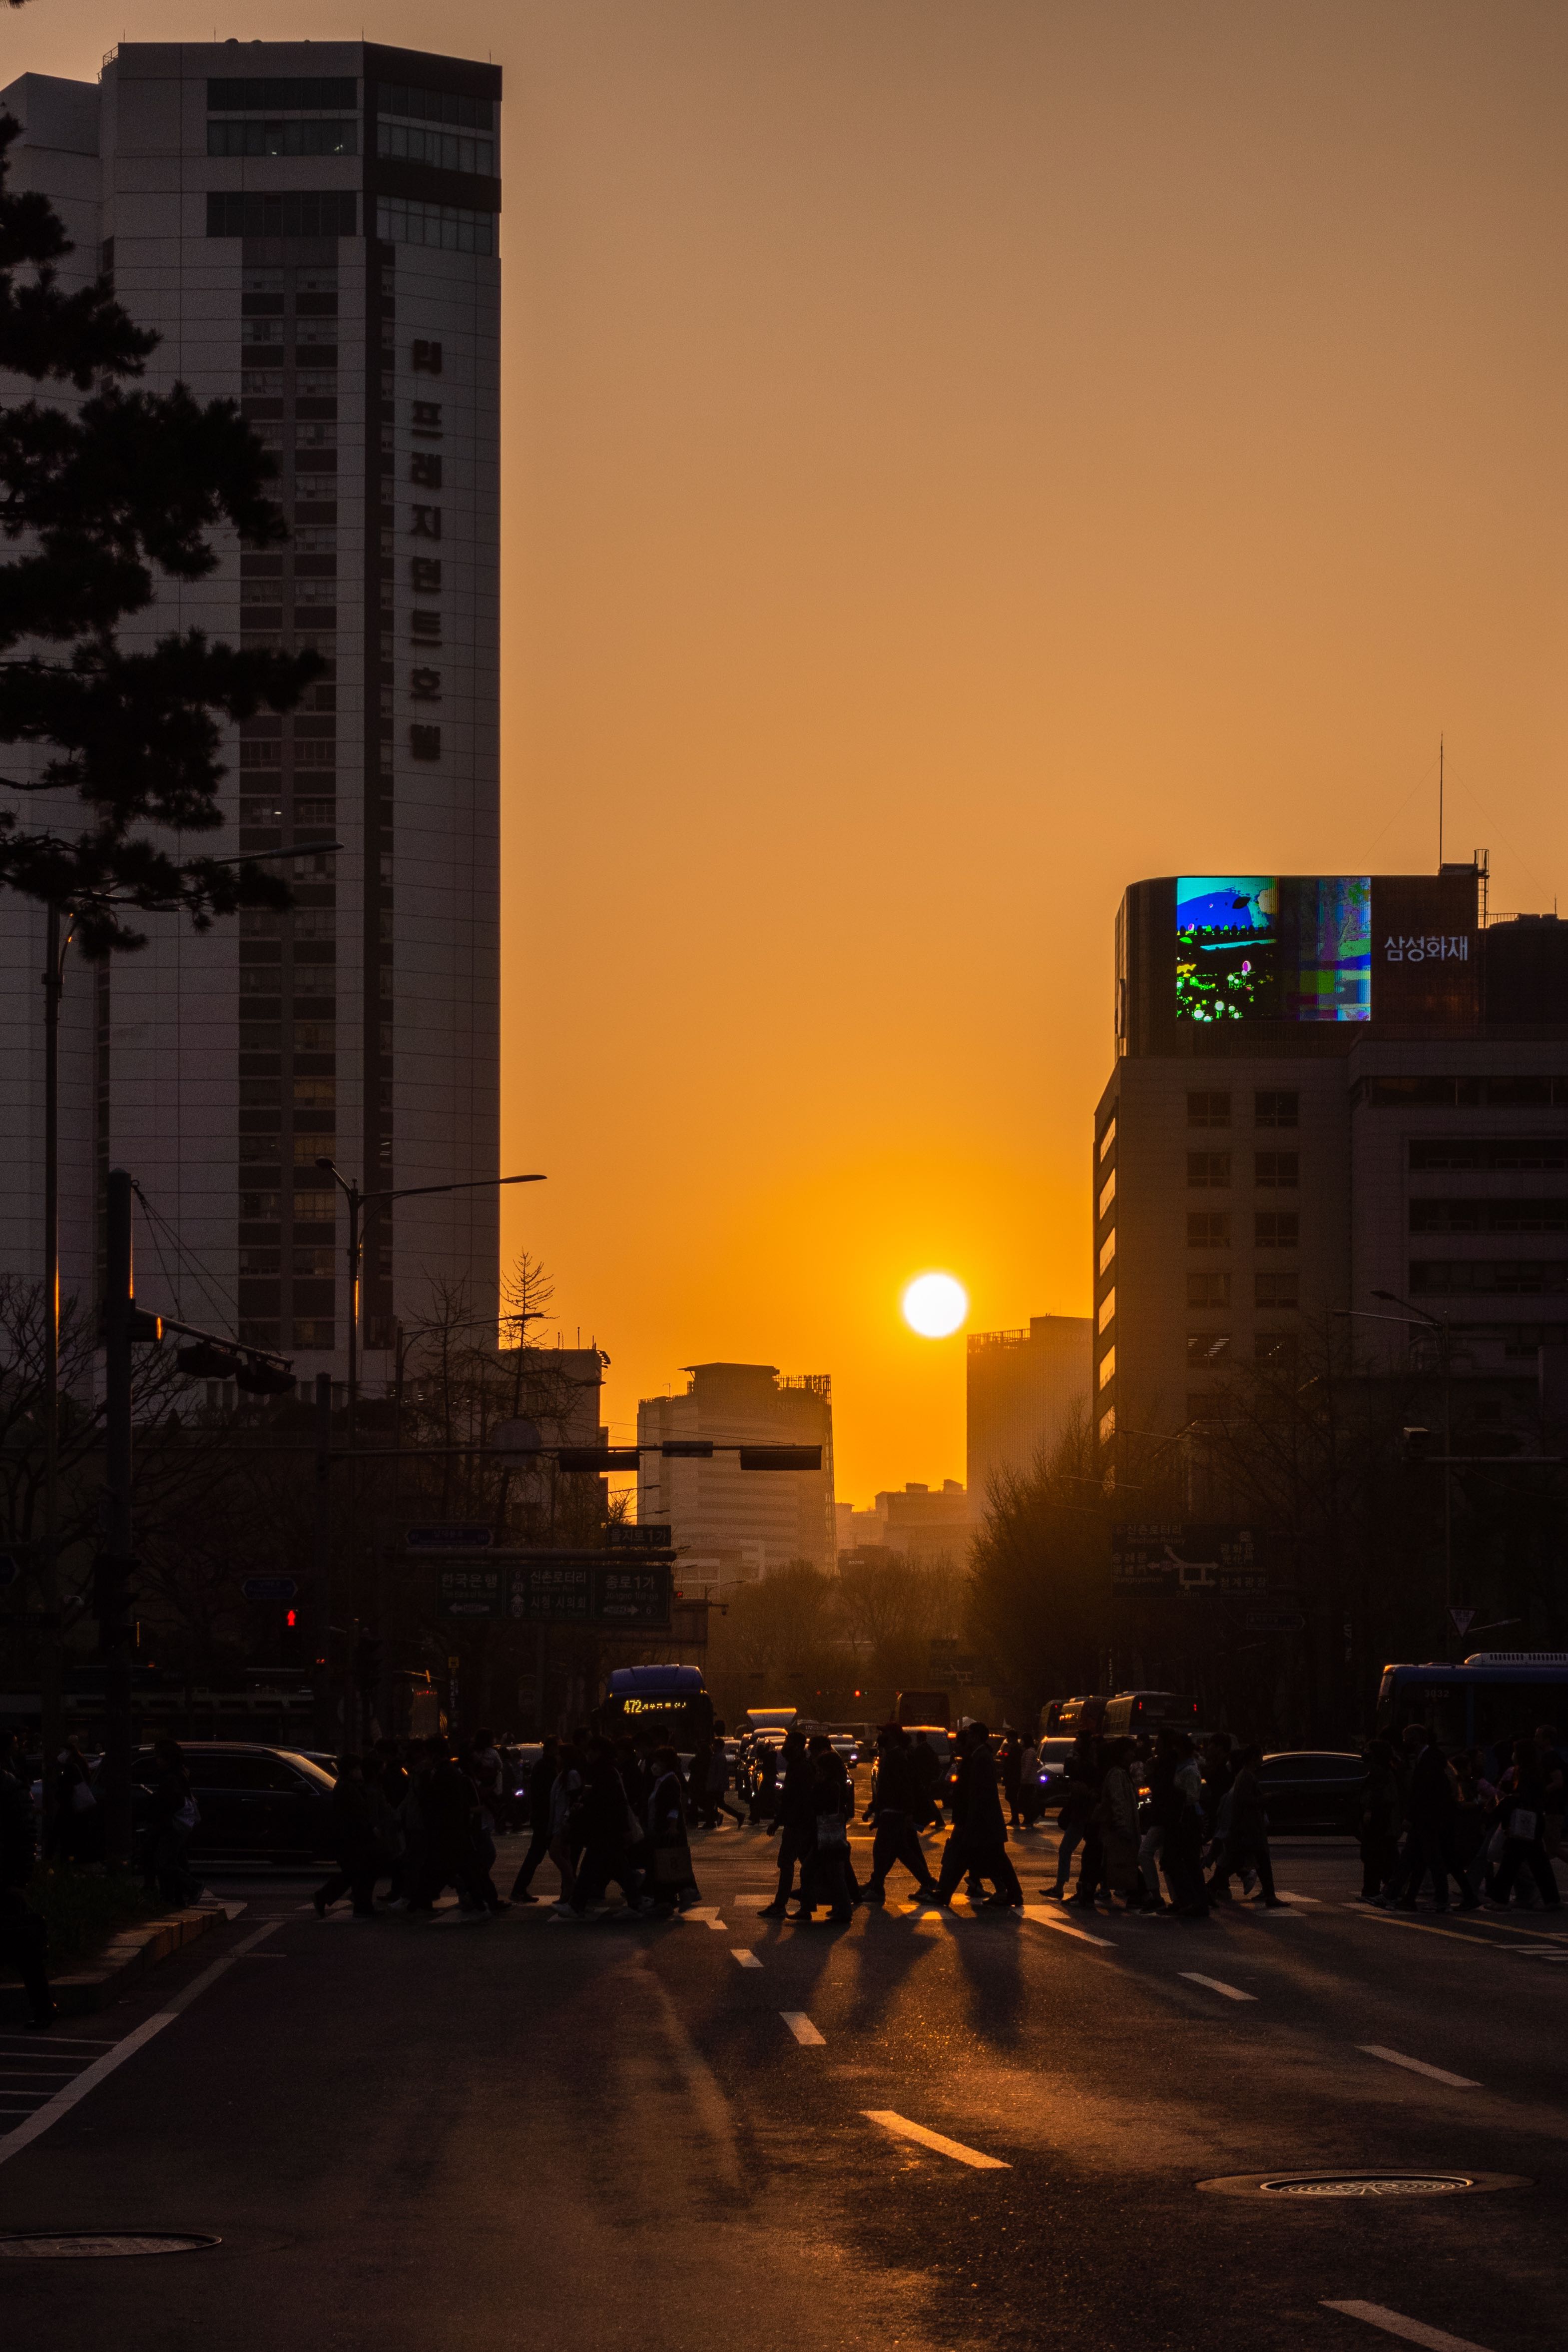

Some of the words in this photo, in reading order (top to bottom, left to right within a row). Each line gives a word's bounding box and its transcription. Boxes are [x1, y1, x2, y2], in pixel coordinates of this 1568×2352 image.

[1384, 935, 1468, 962] 삼성화재
[610, 1528, 667, 1543] 을지로1가
[1126, 1524, 1182, 1535] 신촌로터리
[1112, 1552, 1147, 1563] 숭례문
[441, 1573, 498, 1588] 한국은행
[530, 1570, 586, 1584] 신촌로터리
[605, 1575, 655, 1590] 종로1가
[1424, 1689, 1451, 1698] 3032
[624, 1699, 642, 1714] 472
